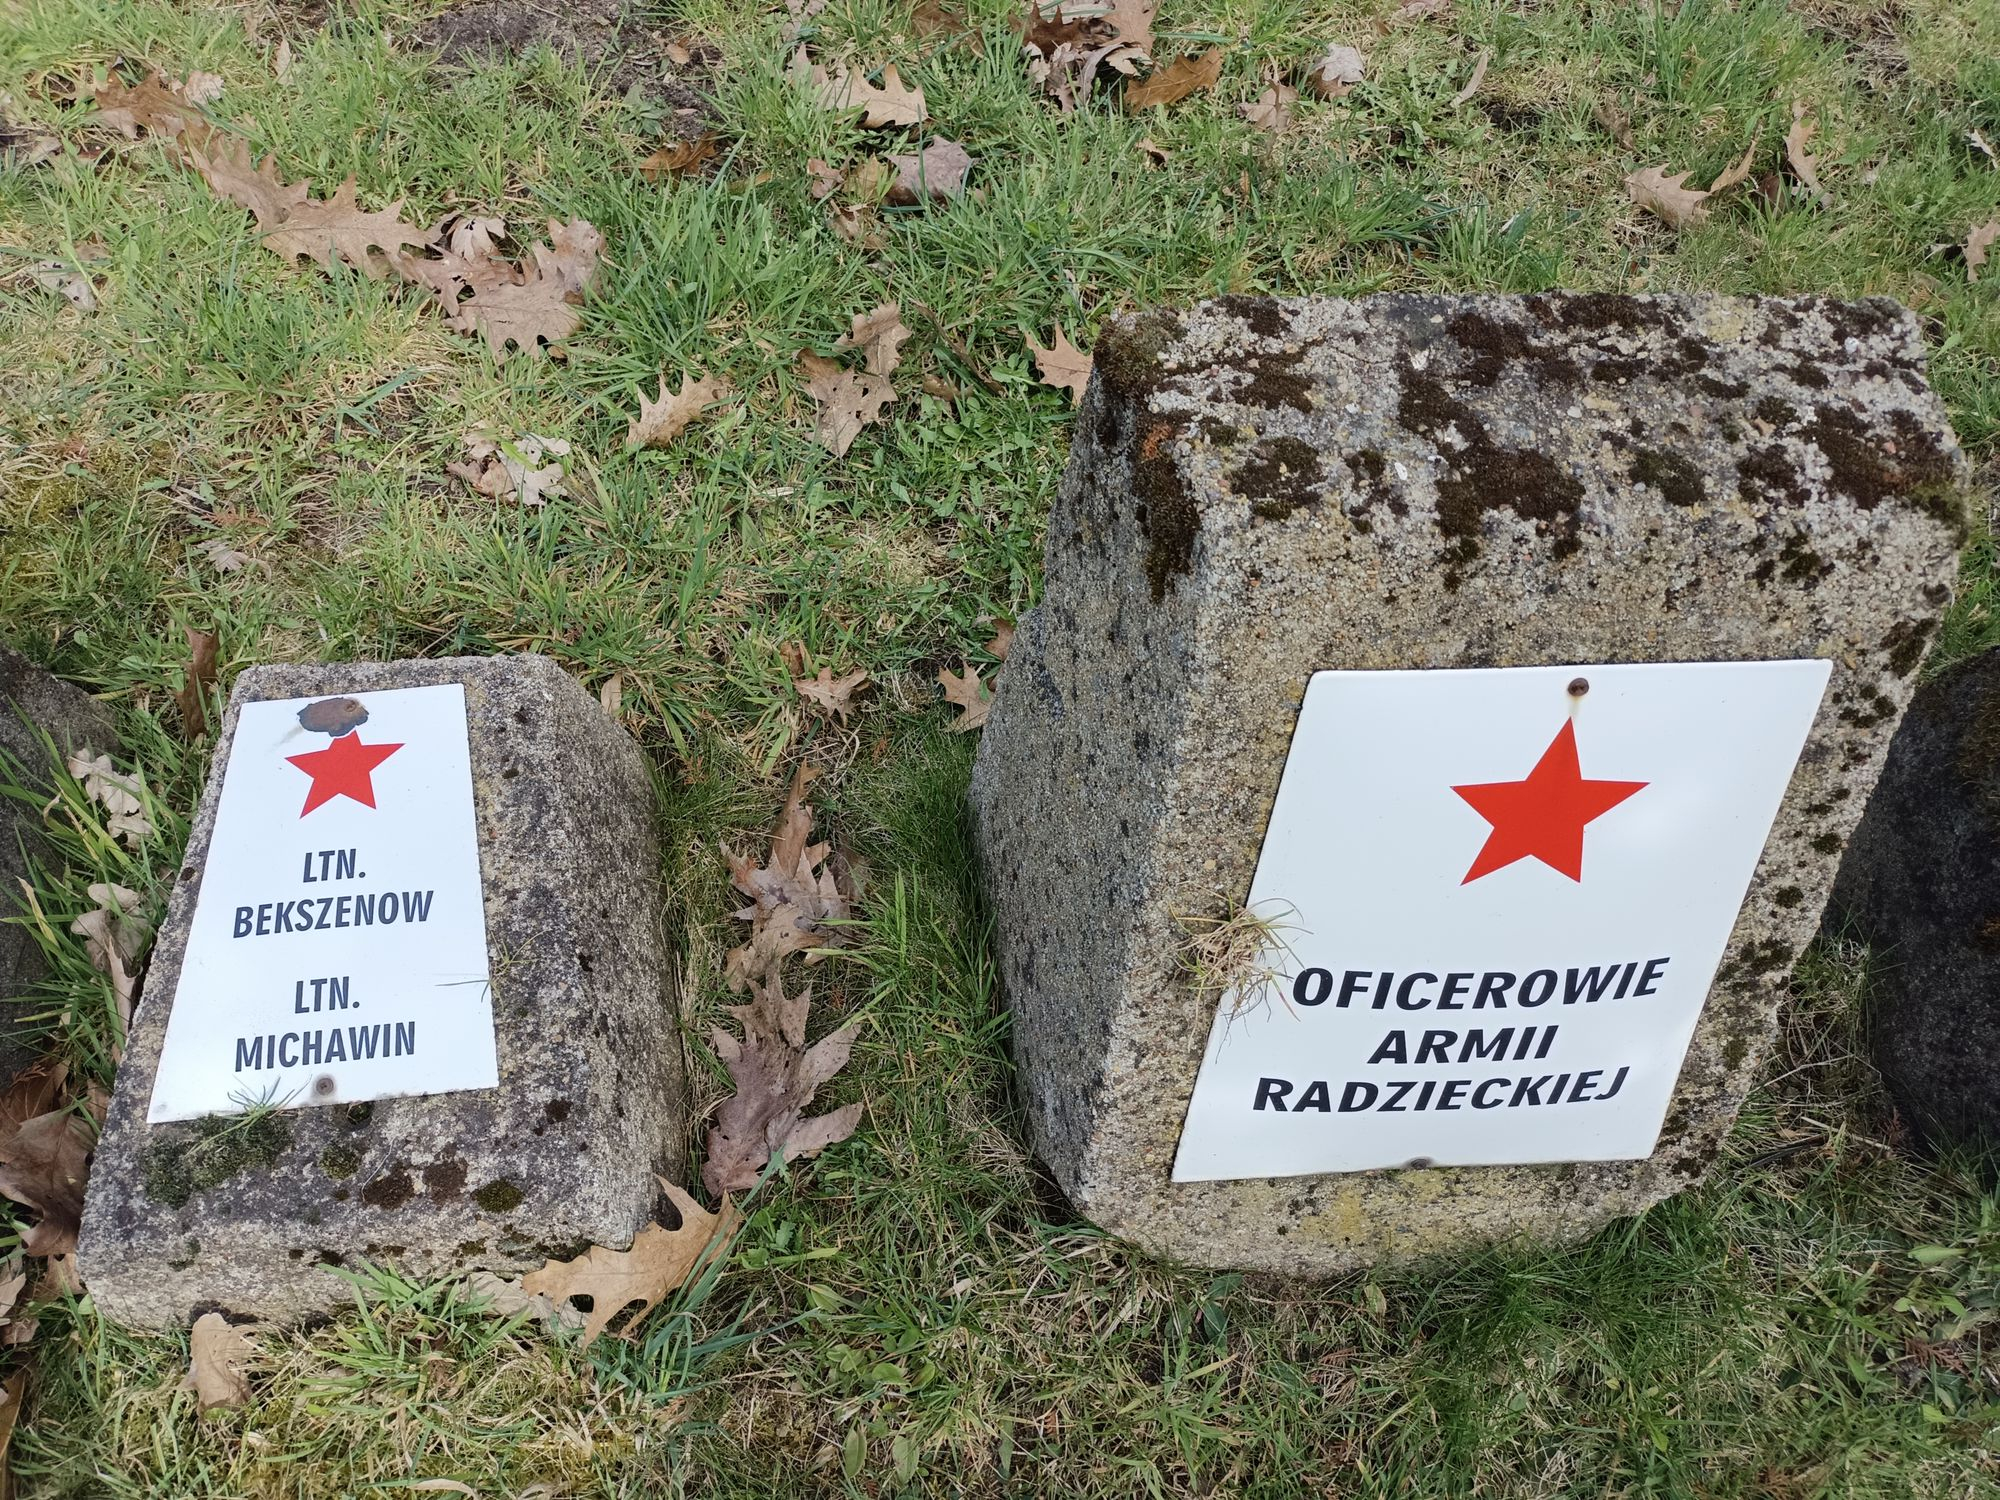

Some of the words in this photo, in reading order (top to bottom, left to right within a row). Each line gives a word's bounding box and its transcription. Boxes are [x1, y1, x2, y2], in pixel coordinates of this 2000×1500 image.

[303, 848, 366, 883] LTN.
[233, 890, 434, 939] BEKSZENOW
[294, 976, 360, 1014] LTN.
[1292, 957, 1671, 1011] OFICEROWIE
[235, 1021, 415, 1073] MICHAWIN
[1366, 1024, 1559, 1065] ARMII
[1252, 1066, 1630, 1113] RADZIECKIEJ
